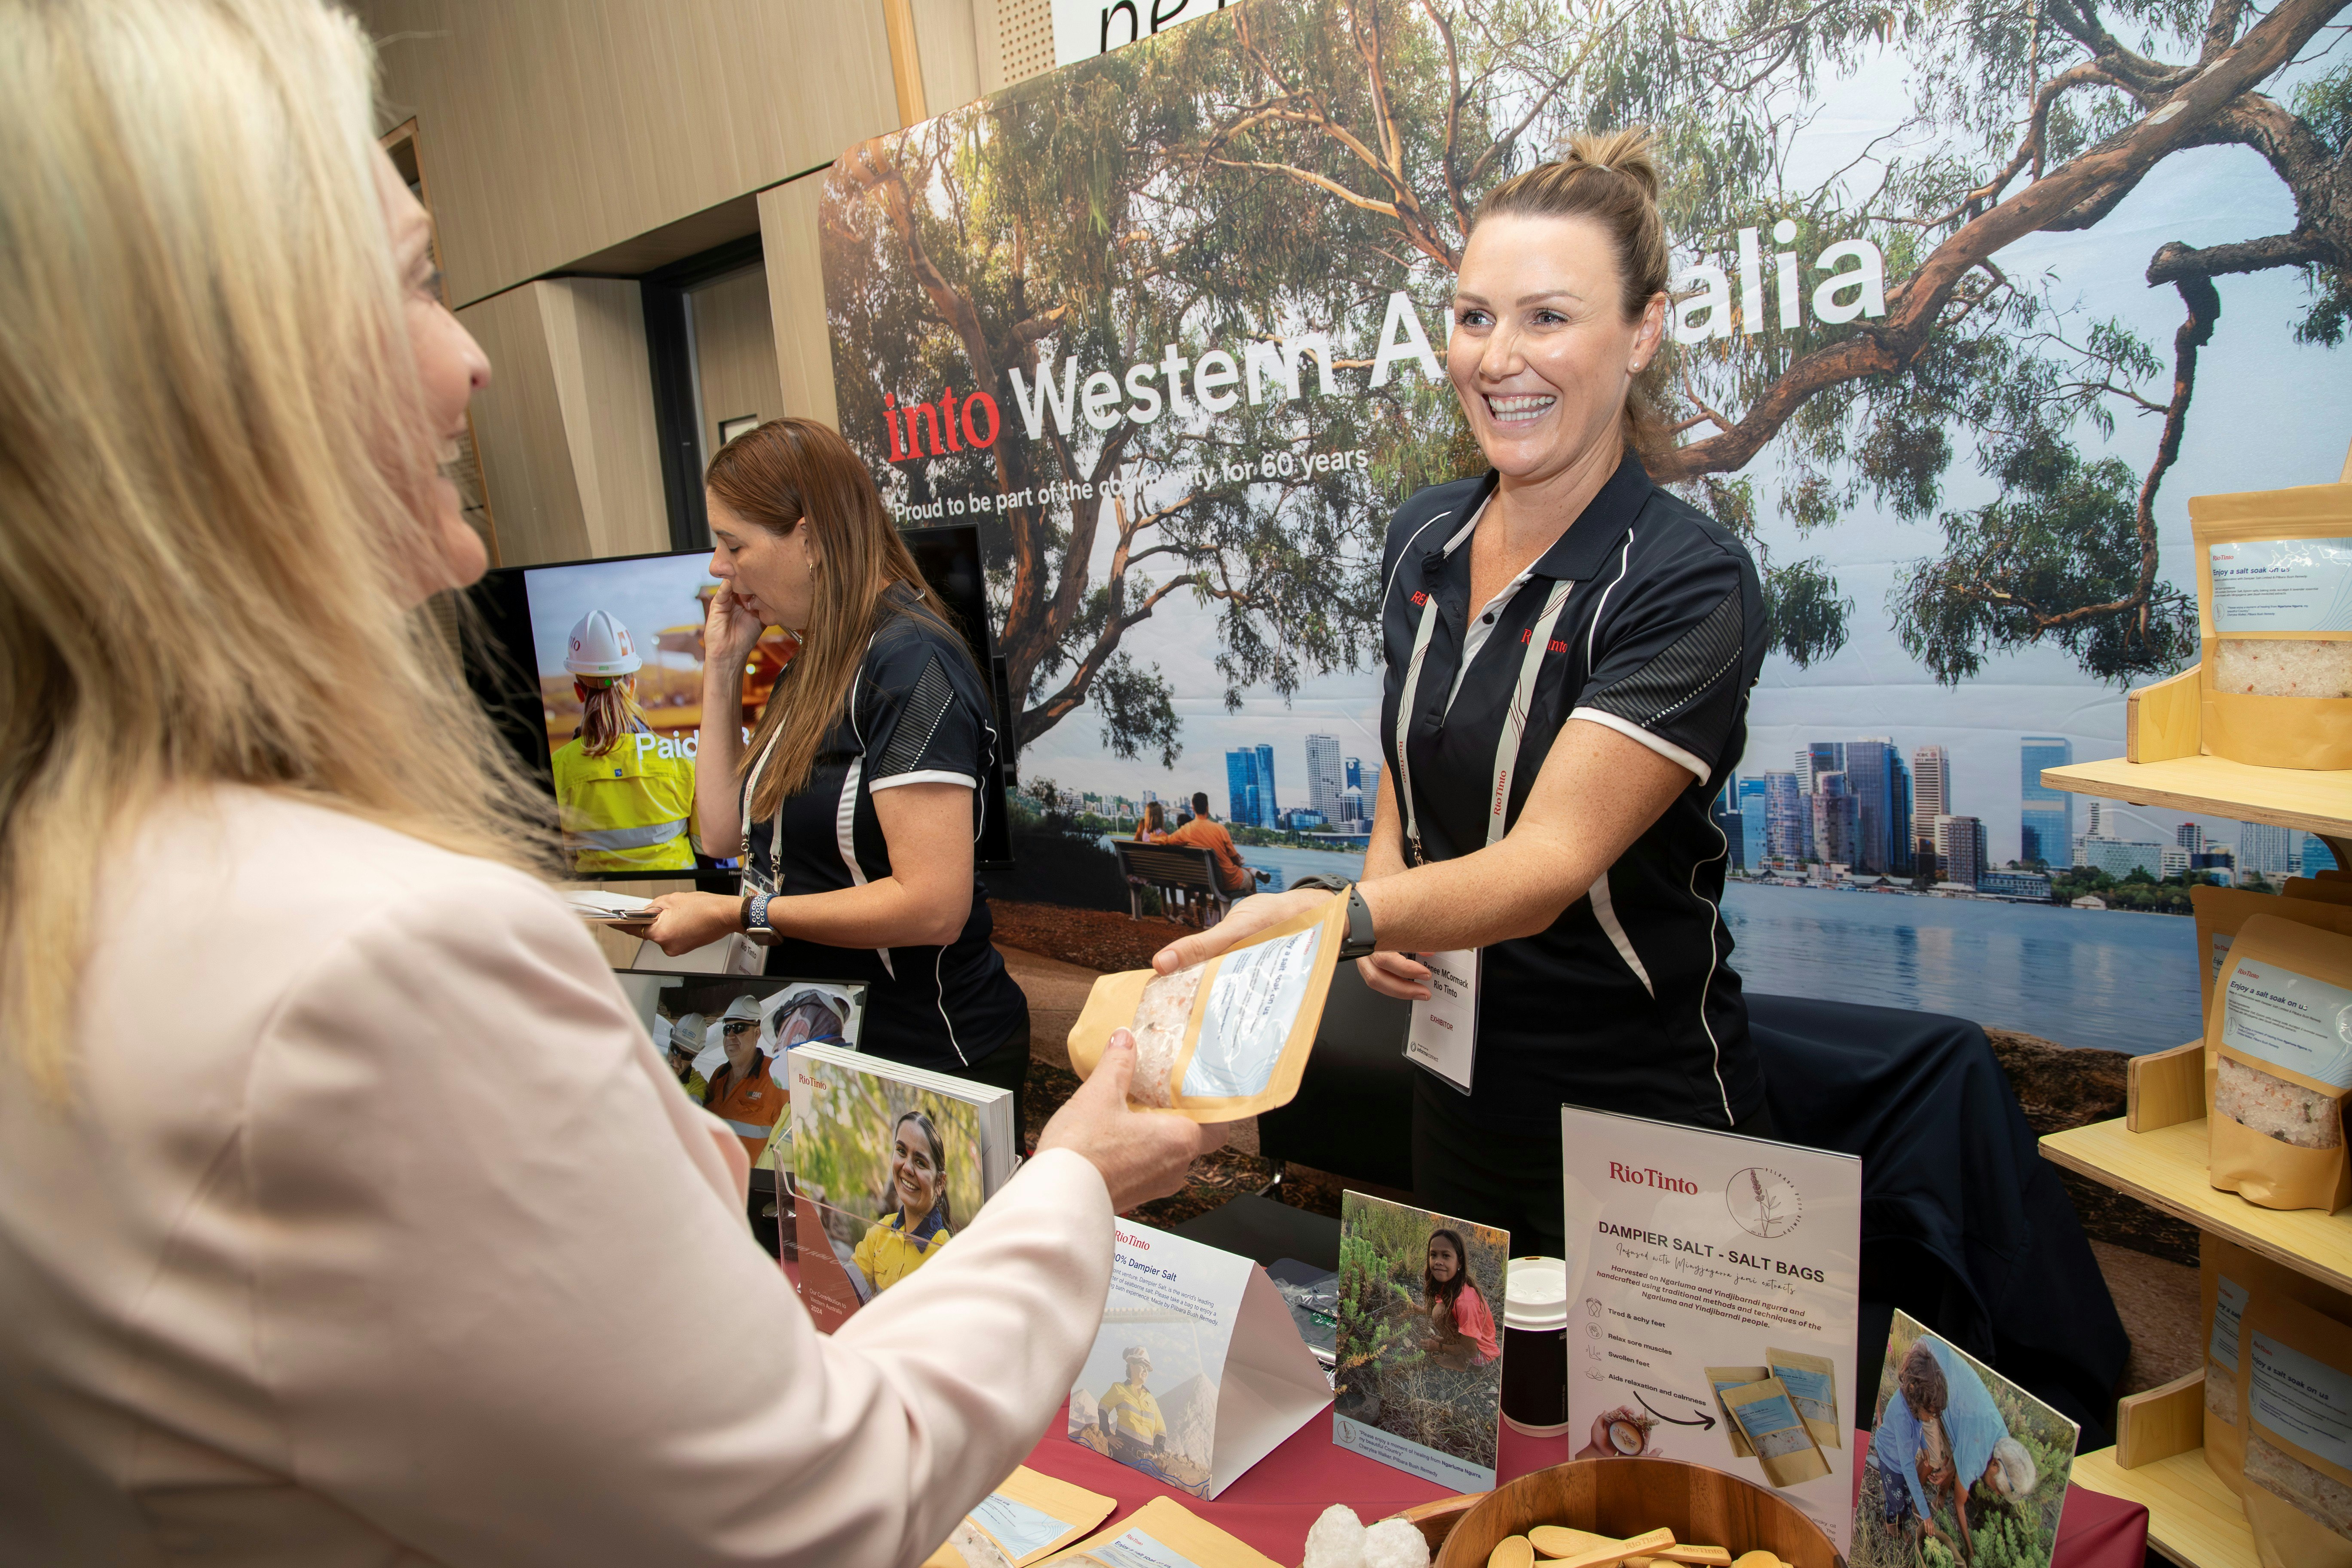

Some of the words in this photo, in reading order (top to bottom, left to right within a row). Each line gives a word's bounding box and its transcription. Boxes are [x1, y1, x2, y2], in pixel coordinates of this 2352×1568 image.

[881, 386, 1000, 464] into
[1008, 331, 1337, 441] Western
[1369, 218, 1886, 389] Aalia
[894, 497, 943, 523] Proud
[947, 497, 965, 516] to
[969, 493, 991, 514] be
[996, 487, 1033, 515] part
[1038, 480, 1057, 505] of
[1062, 479, 1094, 502] the
[1221, 457, 1254, 484] for
[1261, 451, 1294, 479] 60
[1301, 447, 1370, 481] years
[635, 729, 699, 760] Paid
[1493, 770, 1507, 816] RioTinto
[747, 946, 756, 959] Tinto
[1268, 993, 1275, 1005] on
[1434, 979, 1442, 991] Rio
[1444, 985, 1458, 998] Tinto
[2230, 981, 2249, 994] Enjoy
[2256, 989, 2269, 998] salt
[2269, 994, 2287, 1004] soak
[1262, 1006, 1271, 1015] us
[1430, 1014, 1453, 1031] EXHIBITOR
[799, 1073, 827, 1091] RioTinto
[1609, 1161, 1698, 1195] RioTinto
[1115, 1230, 1150, 1250] RioTinto
[1599, 1221, 1669, 1247] DAMPIER
[1673, 1238, 1714, 1257] SALT
[1728, 1250, 1771, 1270] SALT
[1776, 1260, 1825, 1283] BAGS
[1616, 1242, 1648, 1260] Infused
[1653, 1253, 1671, 1264] with
[1128, 1258, 1160, 1275] Dampier
[1161, 1270, 1177, 1282] Salt
[817, 1292, 841, 1308] Contribution
[1122, 1271, 1138, 1282] venture,
[1139, 1276, 1157, 1288] Dampier
[1158, 1283, 1167, 1292] Salt,
[1181, 1291, 1196, 1302] world's
[1197, 1297, 1214, 1308] leading
[1124, 1279, 1145, 1291] seaborne
[1155, 1290, 1169, 1300] Please
[1170, 1295, 1180, 1304] take
[1184, 1301, 1193, 1310] bag
[1200, 1307, 1213, 1317] enjoy
[1597, 1271, 1640, 1286] handcrafted
[1642, 1281, 1661, 1292] using
[1662, 1284, 1702, 1301] traditional
[1703, 1297, 1736, 1310] methods
[1737, 1304, 1752, 1313] and
[1753, 1308, 1797, 1325] techniques
[1808, 1321, 1822, 1330] the
[1611, 1265, 1648, 1280] Harvested
[1660, 1277, 1697, 1290] Ngarluma
[1697, 1285, 1712, 1294] and
[1714, 1289, 1761, 1306] Yindjibarndi
[1762, 1302, 1788, 1312] ngurra
[1789, 1308, 1805, 1317] and
[810, 1296, 825, 1308] Western
[826, 1303, 842, 1315] Australia
[811, 1305, 823, 1315] 2024
[1115, 1284, 1125, 1292] bath
[1151, 1296, 1163, 1306] Made
[1170, 1304, 1186, 1314] Pilbara
[1187, 1310, 1198, 1318] Bush
[1199, 1314, 1219, 1326] Remedy.
[1642, 1291, 1678, 1305] Ngarluma
[1678, 1300, 1694, 1308] and
[1695, 1304, 1741, 1320] Yindjibarndi
[1741, 1316, 1770, 1329] people.
[1608, 1308, 1626, 1317] Tired
[1633, 1314, 1650, 1323] achy
[1651, 1319, 1666, 1327] feet
[1608, 1334, 1626, 1342] Relax
[1644, 1343, 1672, 1354] muscles
[1608, 1351, 1635, 1362] Swollen
[1635, 1358, 1650, 1367] feet
[1624, 1378, 1658, 1392] relaxation
[1673, 1392, 1706, 1405] calmness
[2273, 1368, 2286, 1379] salt
[2288, 1375, 2305, 1388] soak
[2307, 1386, 2317, 1395] on
[2319, 1392, 2329, 1400] us
[1366, 1438, 1384, 1449] beautiful
[1375, 1435, 1386, 1445] enjoy
[1390, 1442, 1408, 1452] moment
[1414, 1449, 1430, 1461] healing
[1430, 1455, 1441, 1464] from
[1442, 1460, 1464, 1473] Ngarluma
[1393, 1456, 1408, 1467] Pilbara
[1409, 1461, 1419, 1470] Bush
[1420, 1466, 1438, 1478] Remedy
[1813, 1518, 1828, 1526] sticky
